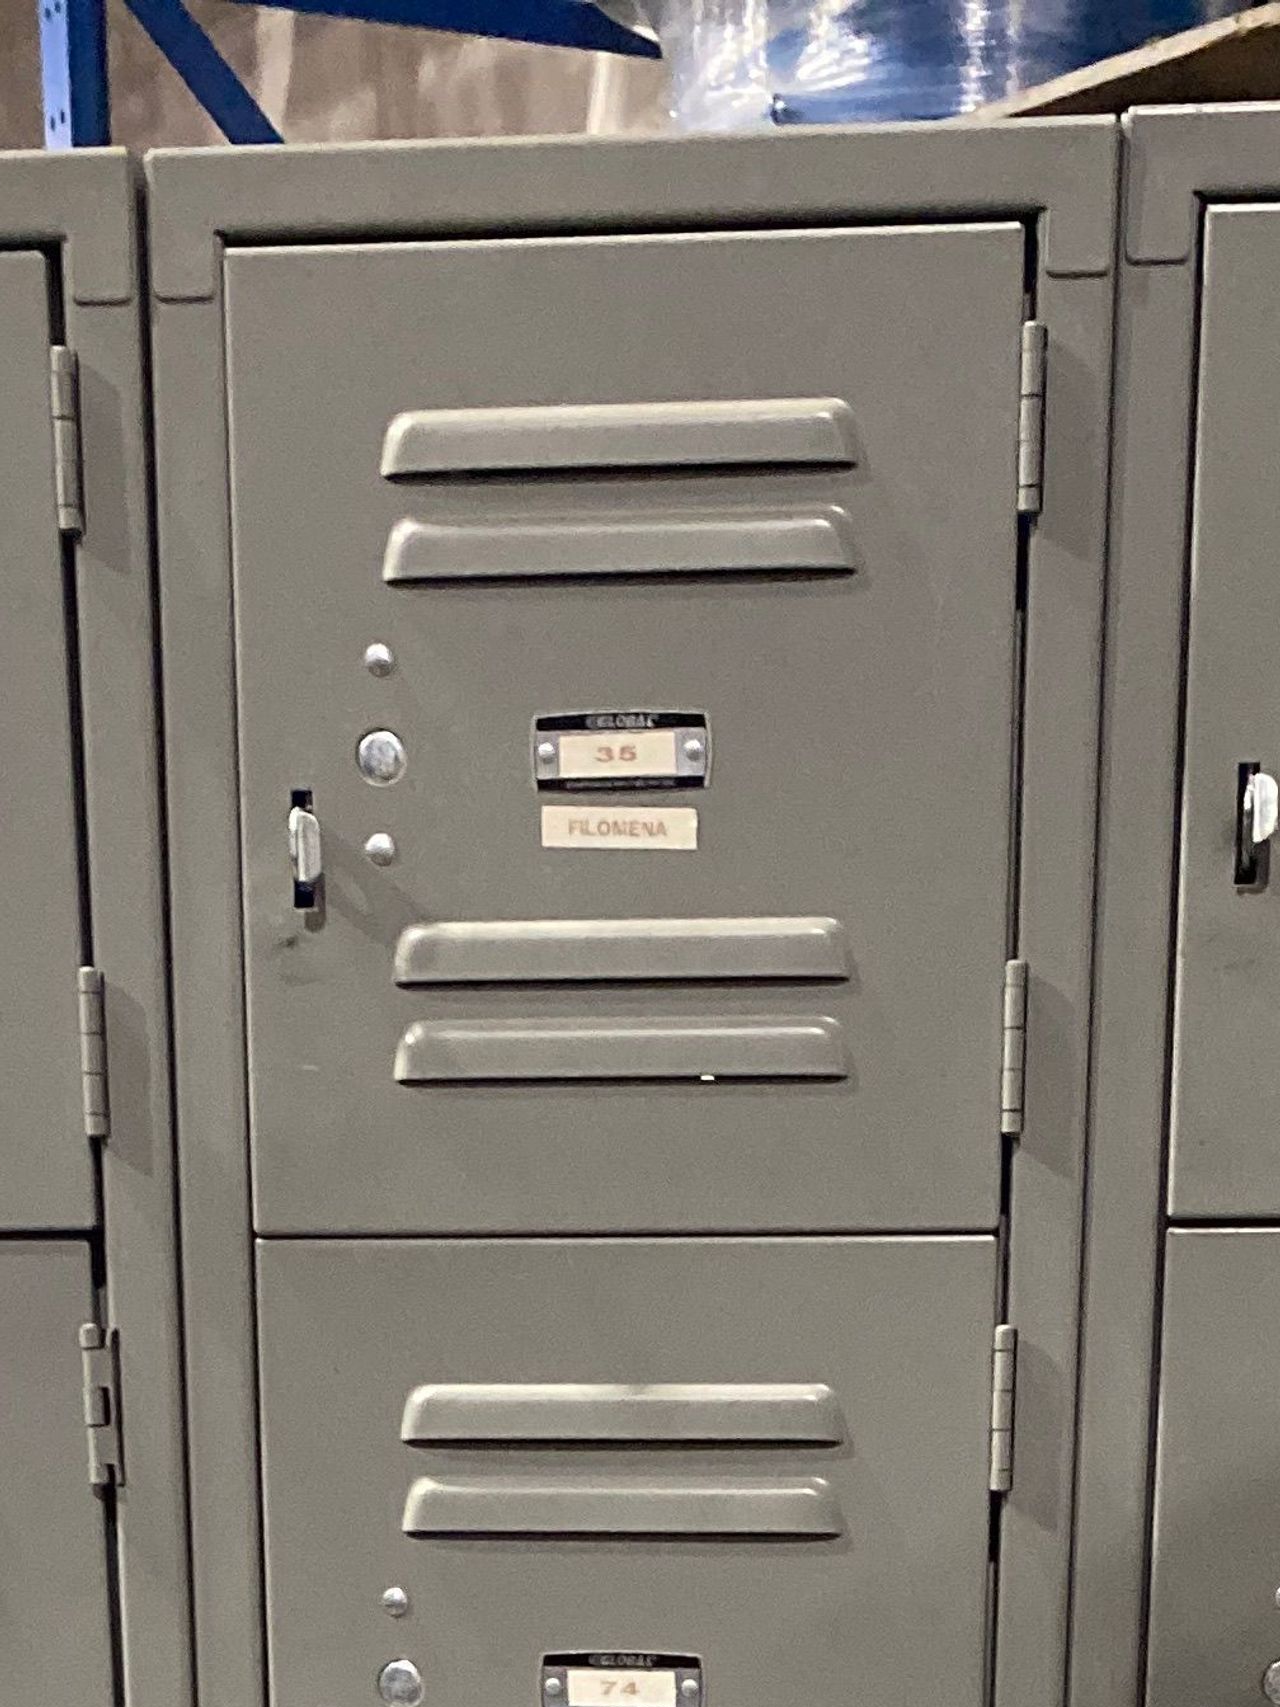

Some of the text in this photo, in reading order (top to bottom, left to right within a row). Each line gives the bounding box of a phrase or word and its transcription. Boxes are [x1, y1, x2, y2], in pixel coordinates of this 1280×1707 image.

[595, 745, 637, 763] 35
[568, 817, 668, 837] FILOMENA
[600, 1681, 640, 1696] 74
